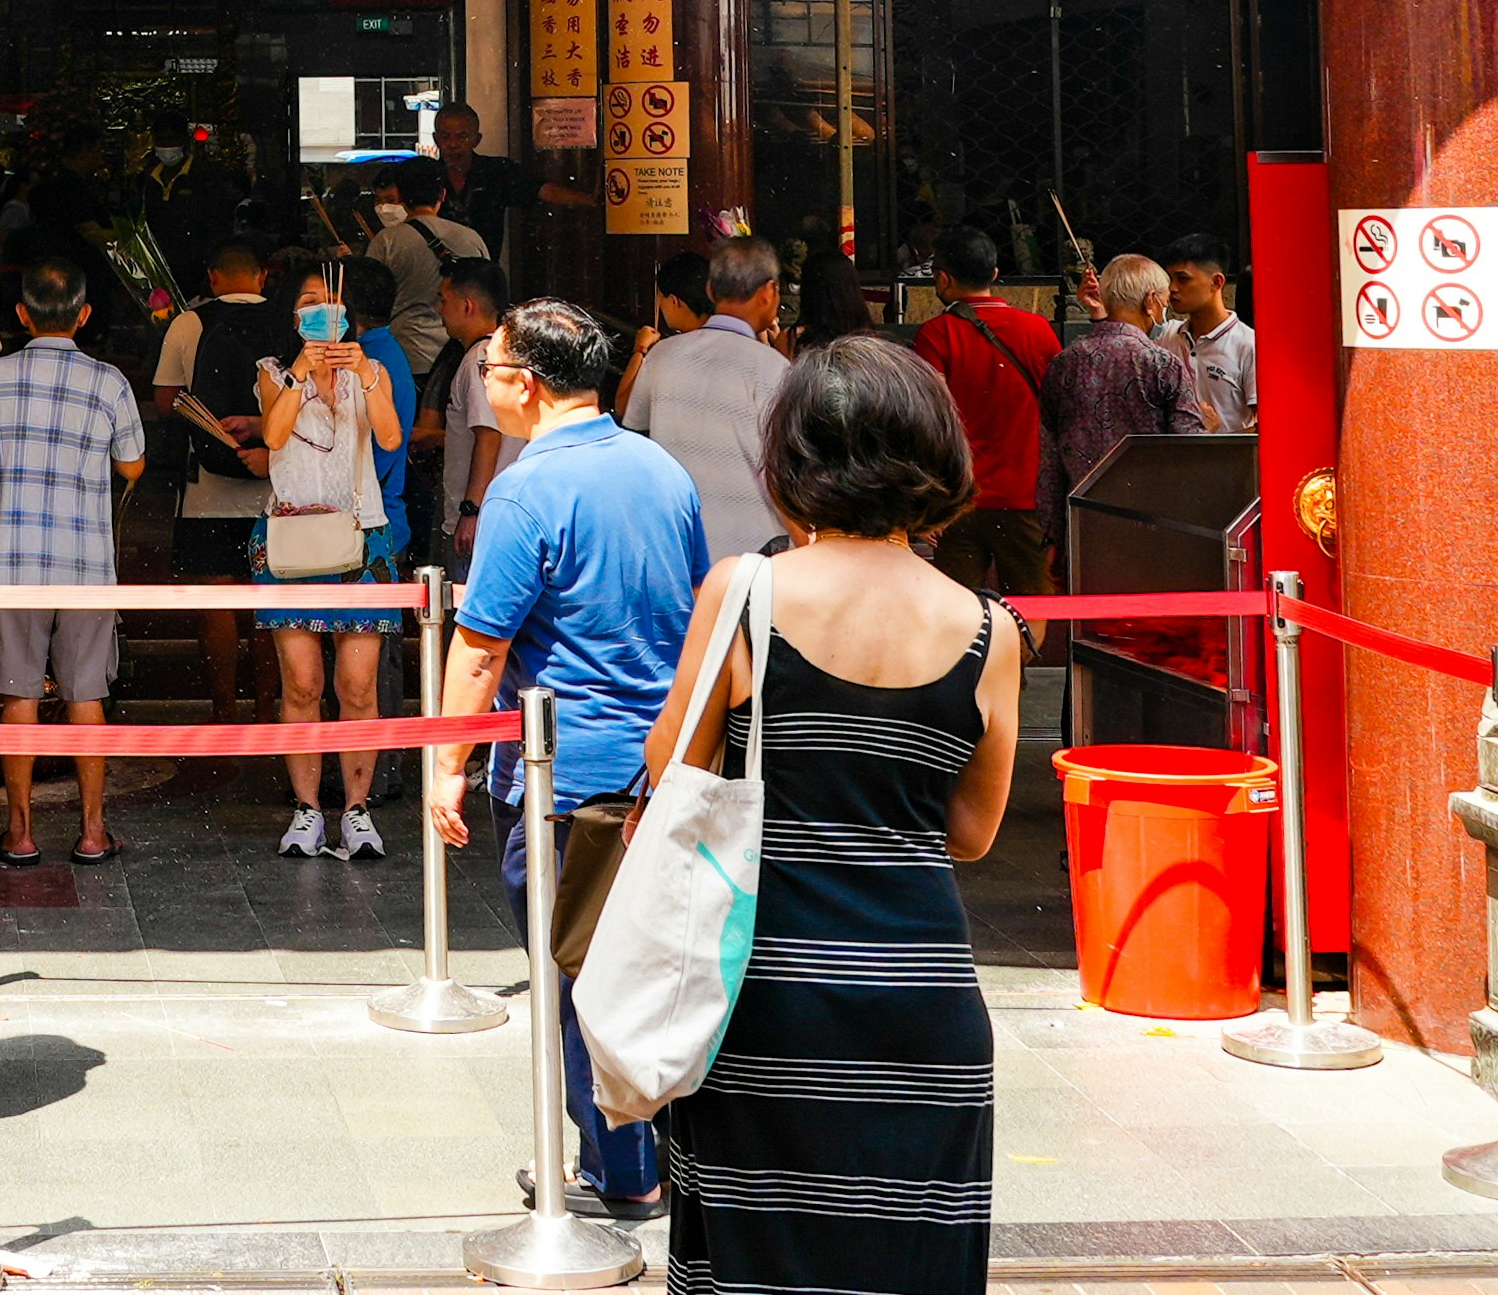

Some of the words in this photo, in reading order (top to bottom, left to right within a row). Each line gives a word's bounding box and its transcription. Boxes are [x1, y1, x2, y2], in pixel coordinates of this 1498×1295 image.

[363, 19, 382, 30] EXIT
[634, 168, 656, 177] TAKE
[658, 167, 684, 177] NOTE
